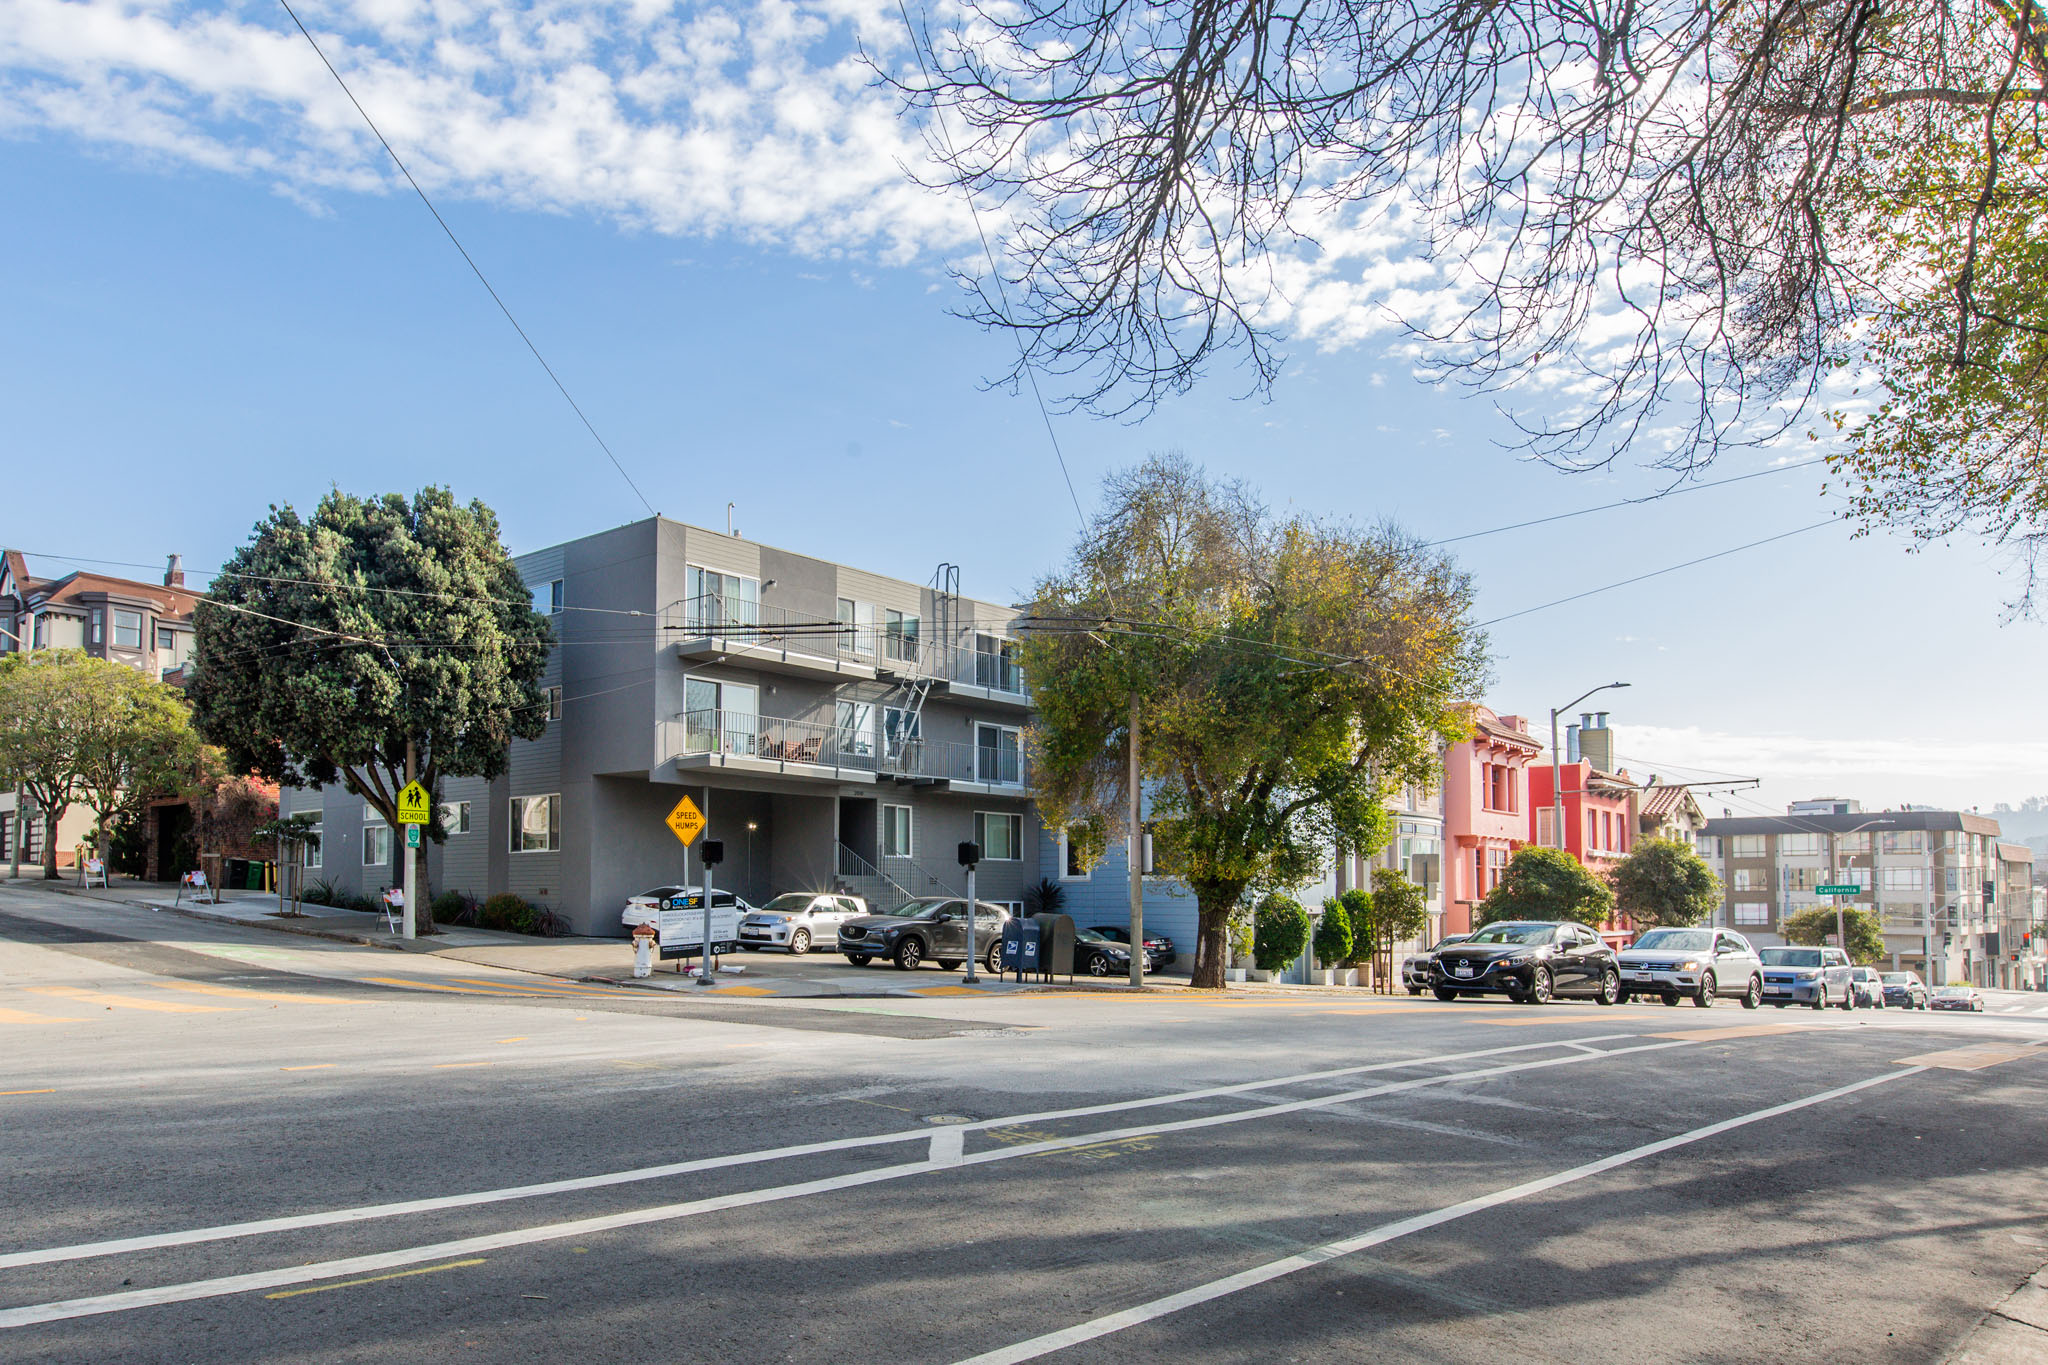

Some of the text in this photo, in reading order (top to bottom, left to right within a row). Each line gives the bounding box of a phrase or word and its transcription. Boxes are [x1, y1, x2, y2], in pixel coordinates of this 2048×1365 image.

[400, 812, 428, 821] SCHOOL
[676, 811, 697, 820] SPEED
[675, 822, 698, 830] HUMPS
